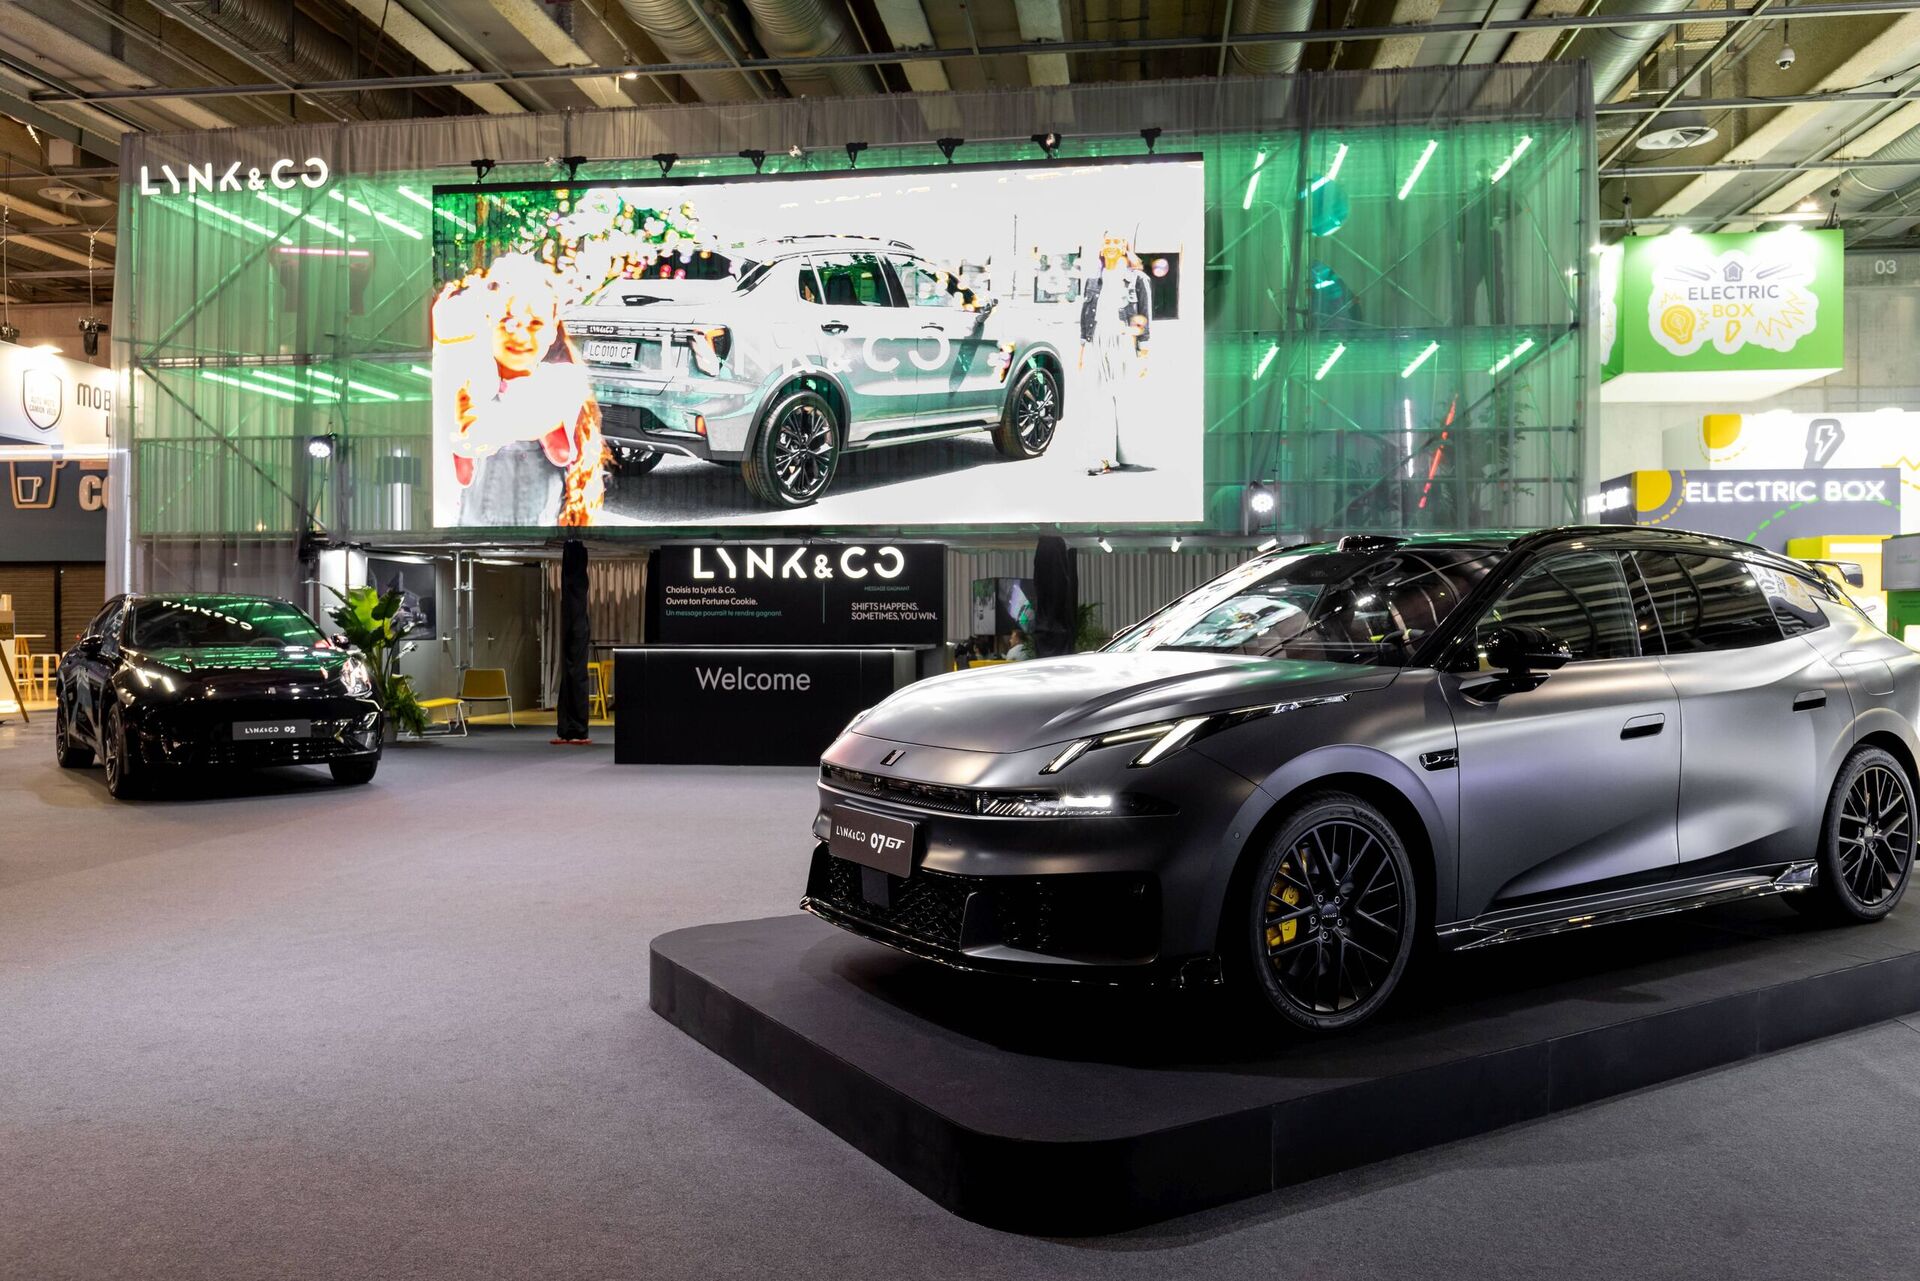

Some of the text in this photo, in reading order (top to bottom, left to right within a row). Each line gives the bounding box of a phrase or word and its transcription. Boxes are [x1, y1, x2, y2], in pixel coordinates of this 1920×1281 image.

[140, 157, 329, 196] LYNK&CO
[1875, 260, 1897, 274] 03
[1688, 284, 1779, 301] ELECTRIC
[1711, 303, 1755, 318] BOX
[1686, 480, 1885, 503] ELECTRIC BOX
[693, 547, 905, 579] LYNK&CO
[665, 585, 737, 596] Choisis ta Lynk & Co.
[665, 597, 758, 606] Ouvre ton Fortune Cookie.
[851, 602, 919, 611] SHIFTS HAPPENS.
[665, 609, 675, 617] Un
[675, 610, 703, 619] message
[703, 609, 727, 618] pourrait
[727, 609, 734, 617] te
[735, 609, 755, 617] rendre
[851, 611, 938, 621] SOMETIMES, YOU WIN.
[695, 667, 811, 691] Welcome
[284, 725, 296, 734] 02
[836, 825, 866, 842] LYNK&CO
